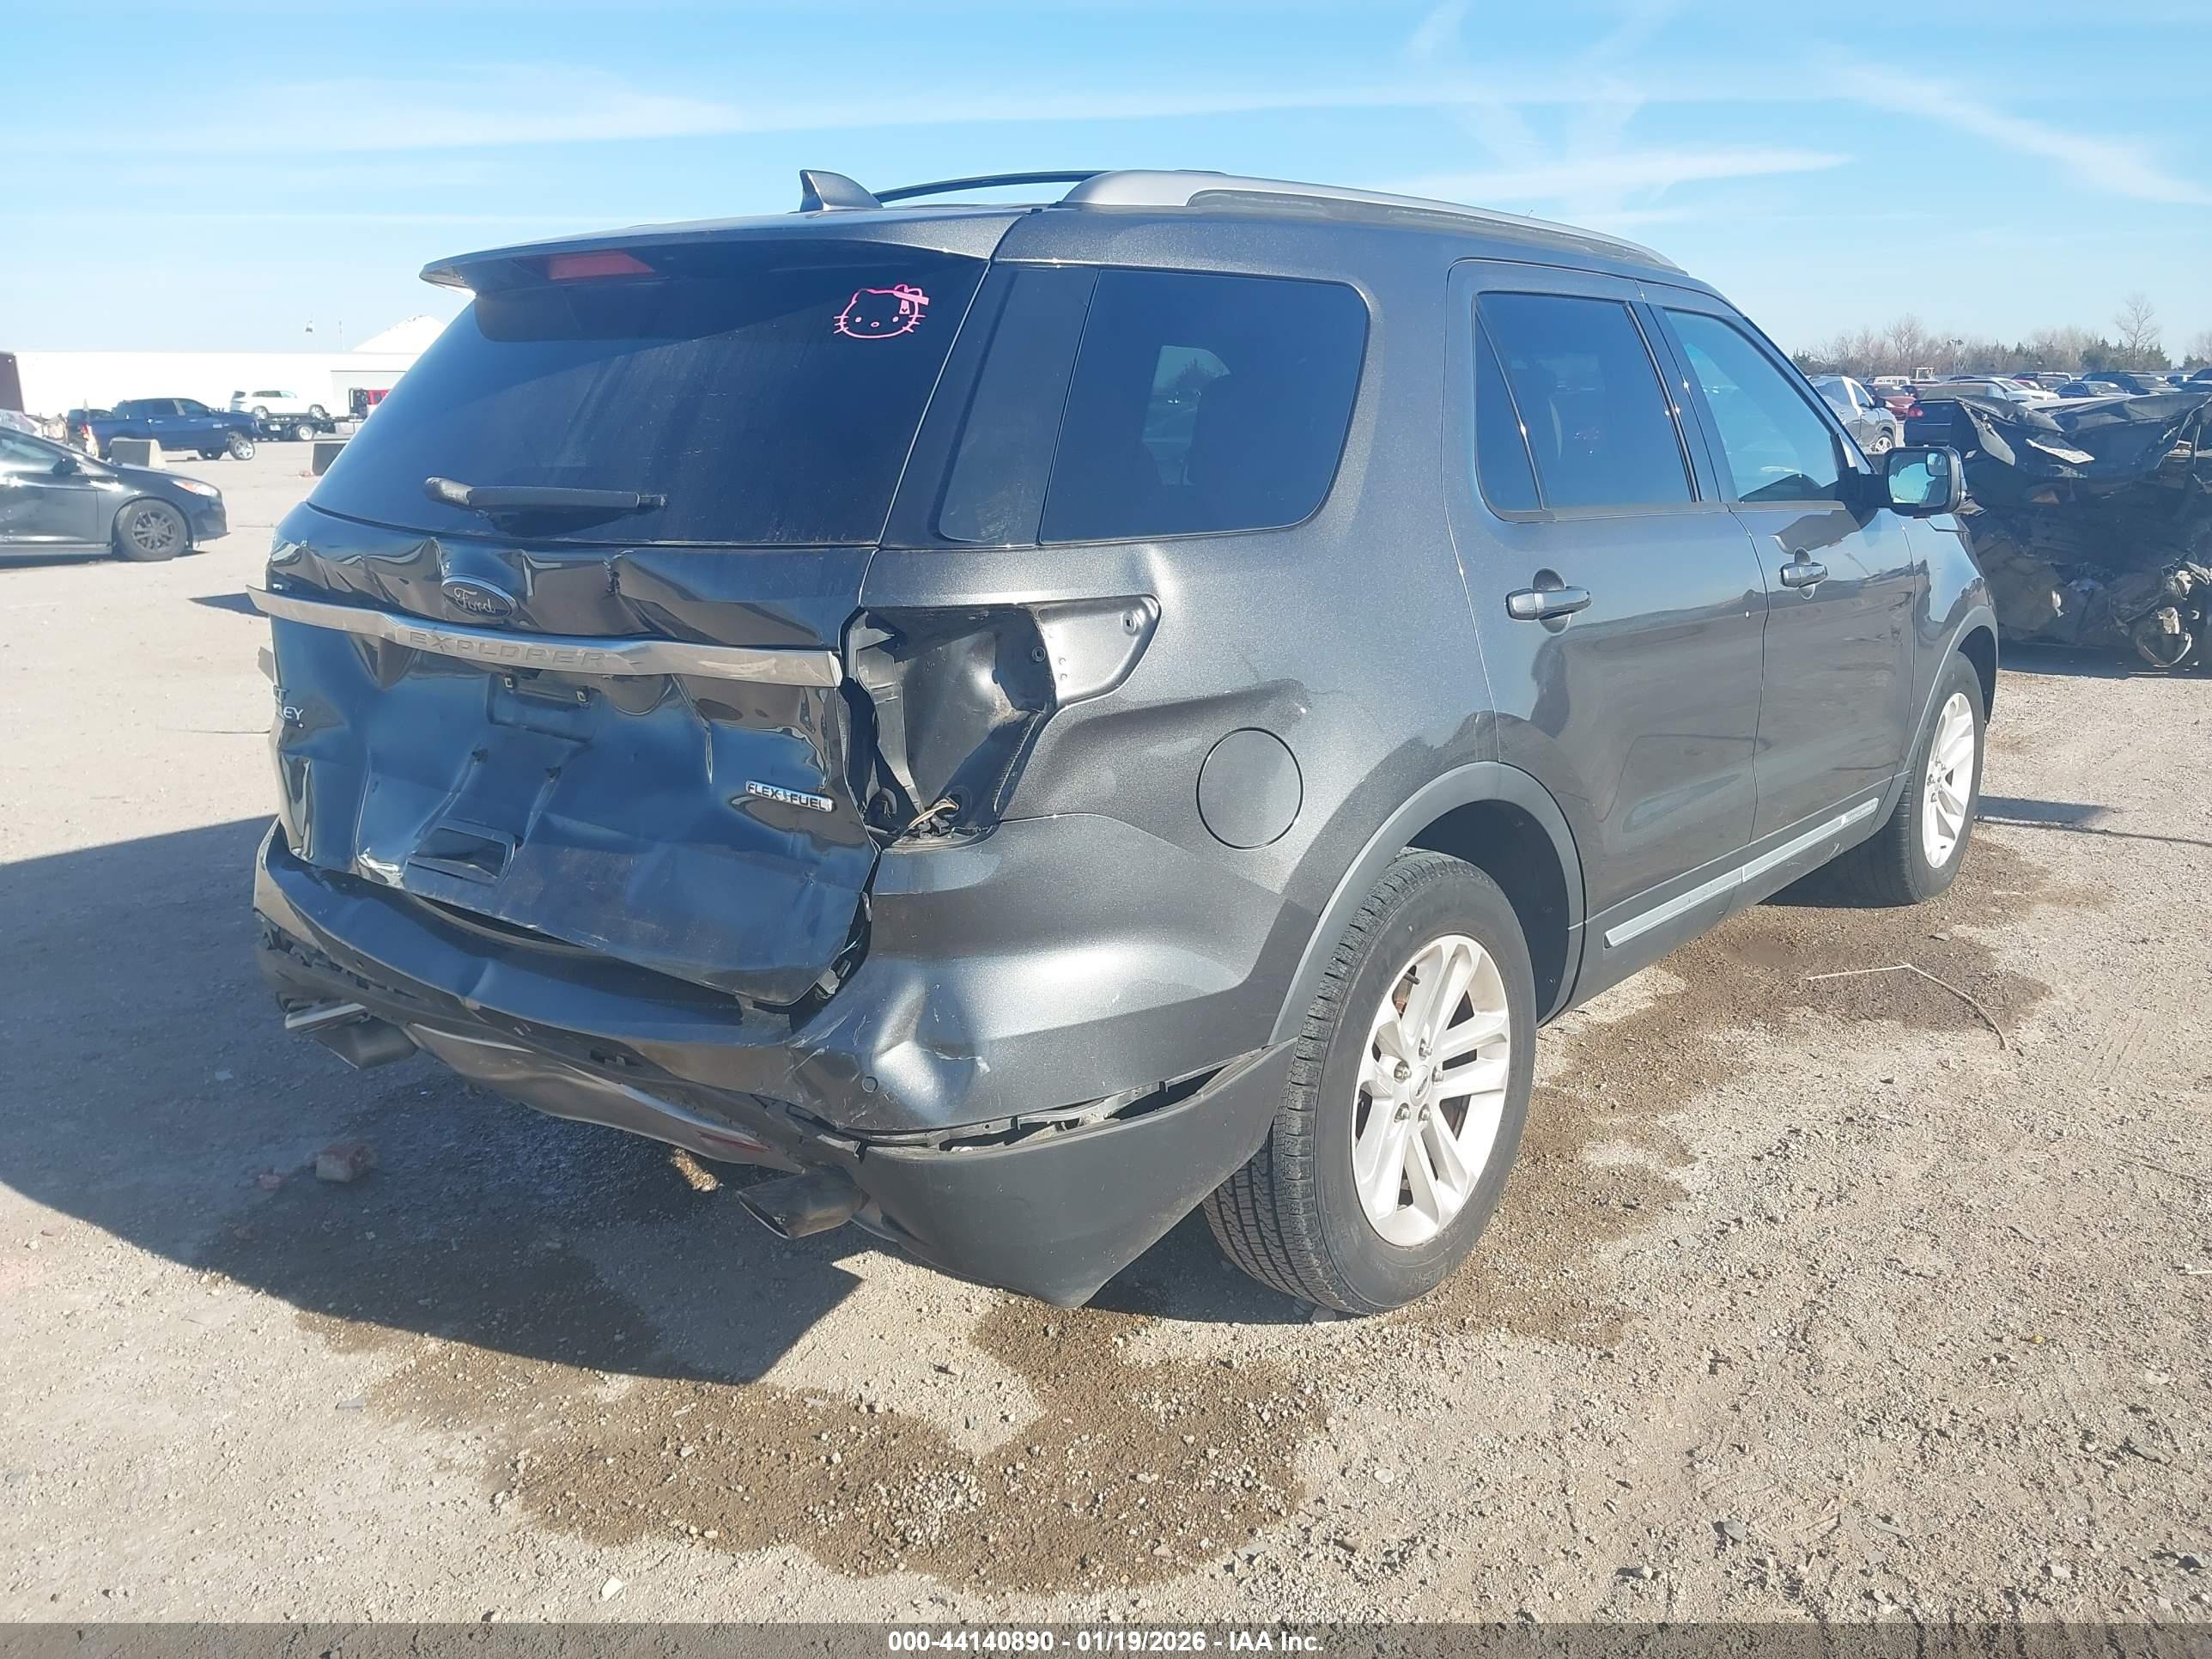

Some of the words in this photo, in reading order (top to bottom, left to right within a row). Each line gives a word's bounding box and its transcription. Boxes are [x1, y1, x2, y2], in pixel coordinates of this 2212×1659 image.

[453, 587, 496, 614] Ford
[410, 630, 605, 667] EXPLORER
[747, 782, 781, 799] FLEX
[790, 793, 827, 811] FUEL
